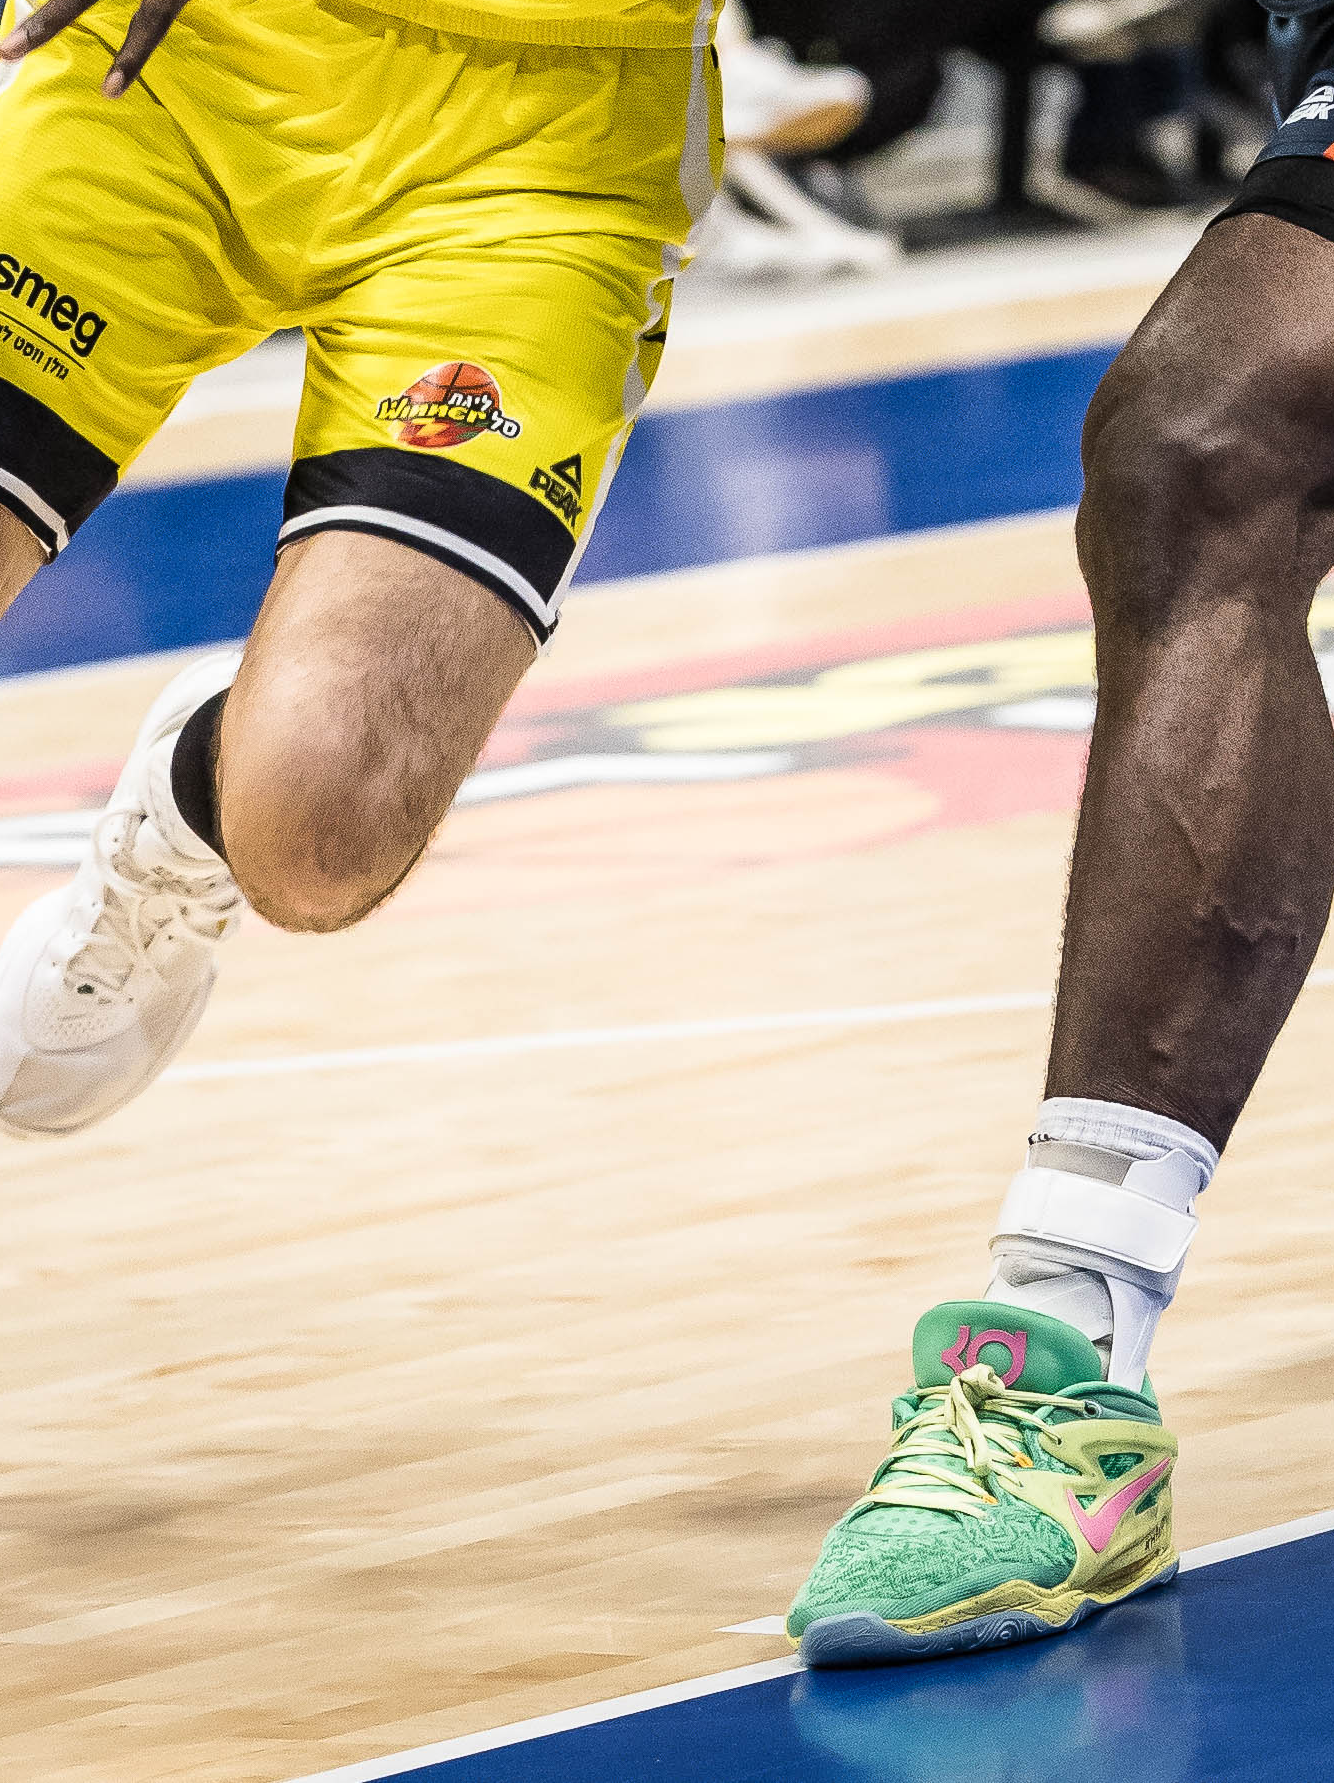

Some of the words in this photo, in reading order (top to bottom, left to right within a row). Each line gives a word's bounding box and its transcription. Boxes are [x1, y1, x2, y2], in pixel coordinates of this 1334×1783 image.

[13, 335, 45, 365] ווסט
[374, 397, 487, 424] Winner
[491, 409, 519, 438] סל
[528, 465, 583, 532] PEAK
